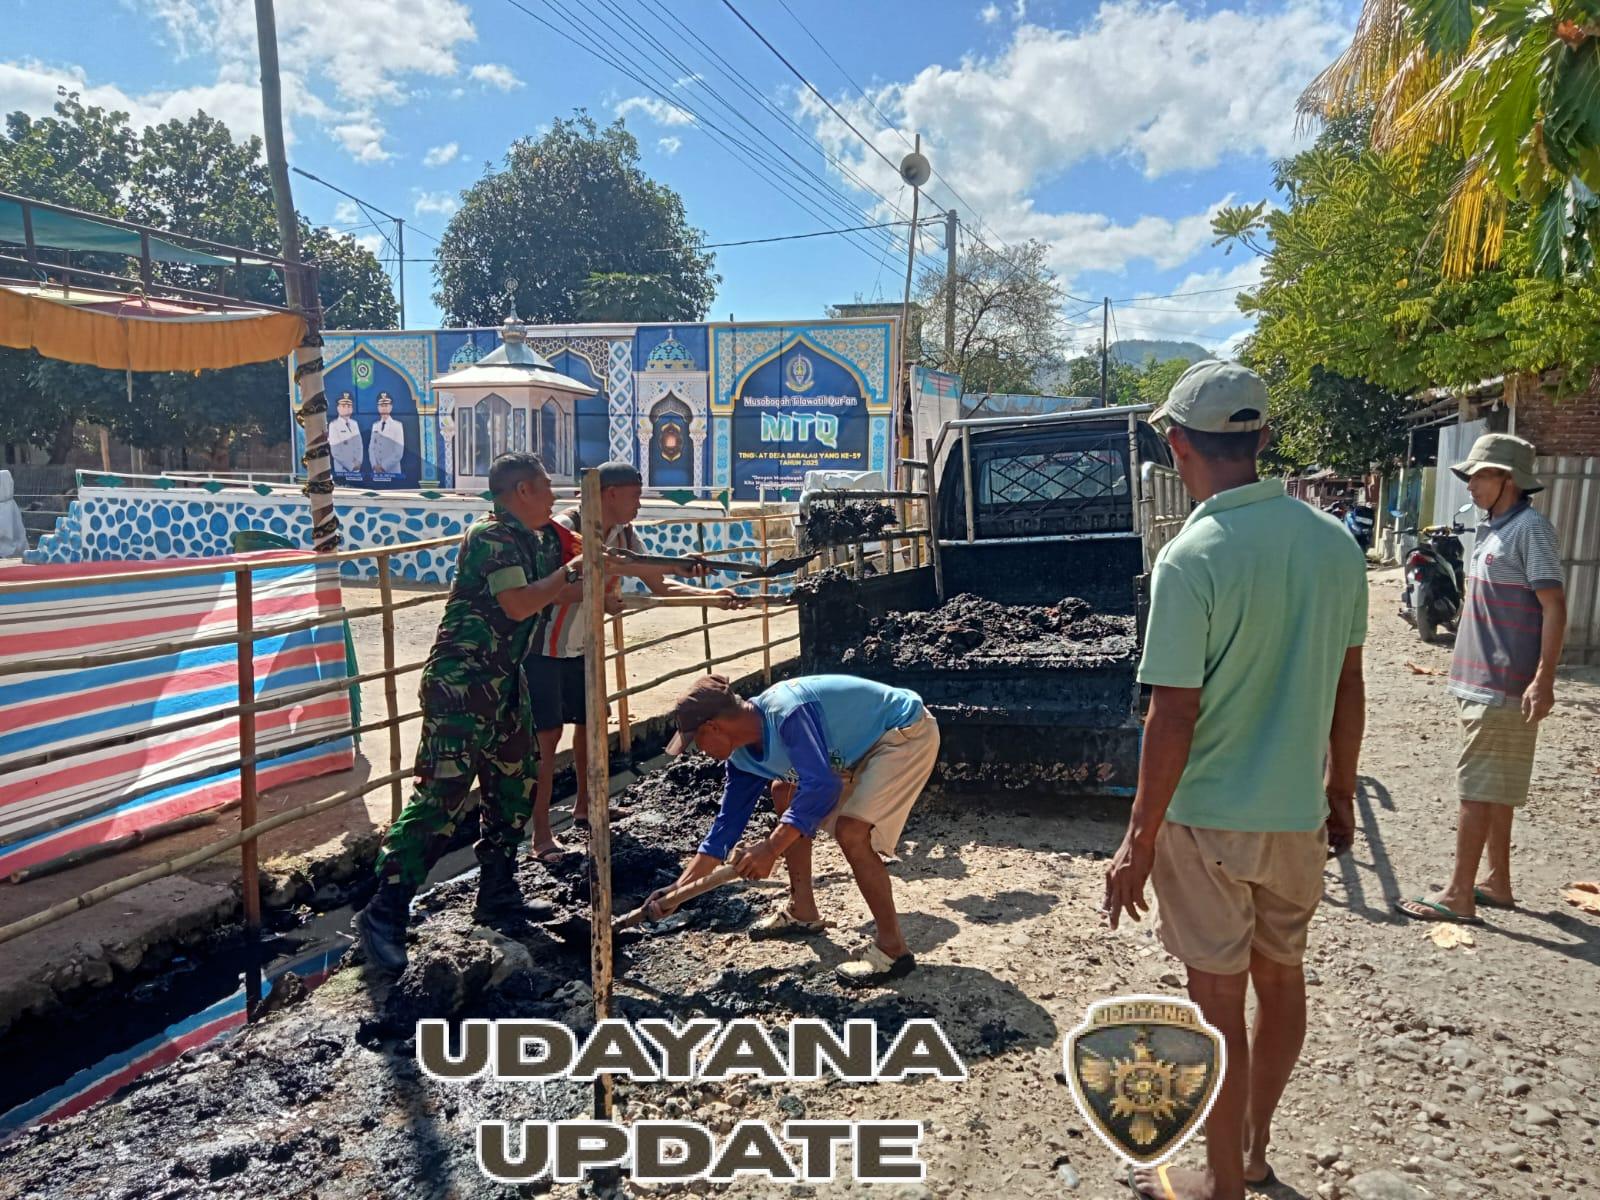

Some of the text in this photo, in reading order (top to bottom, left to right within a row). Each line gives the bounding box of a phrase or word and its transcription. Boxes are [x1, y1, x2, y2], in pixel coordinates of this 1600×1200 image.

[791, 395, 827, 407] Tilawatil
[828, 395, 858, 407] Qur'an
[761, 411, 839, 449] MTQ
